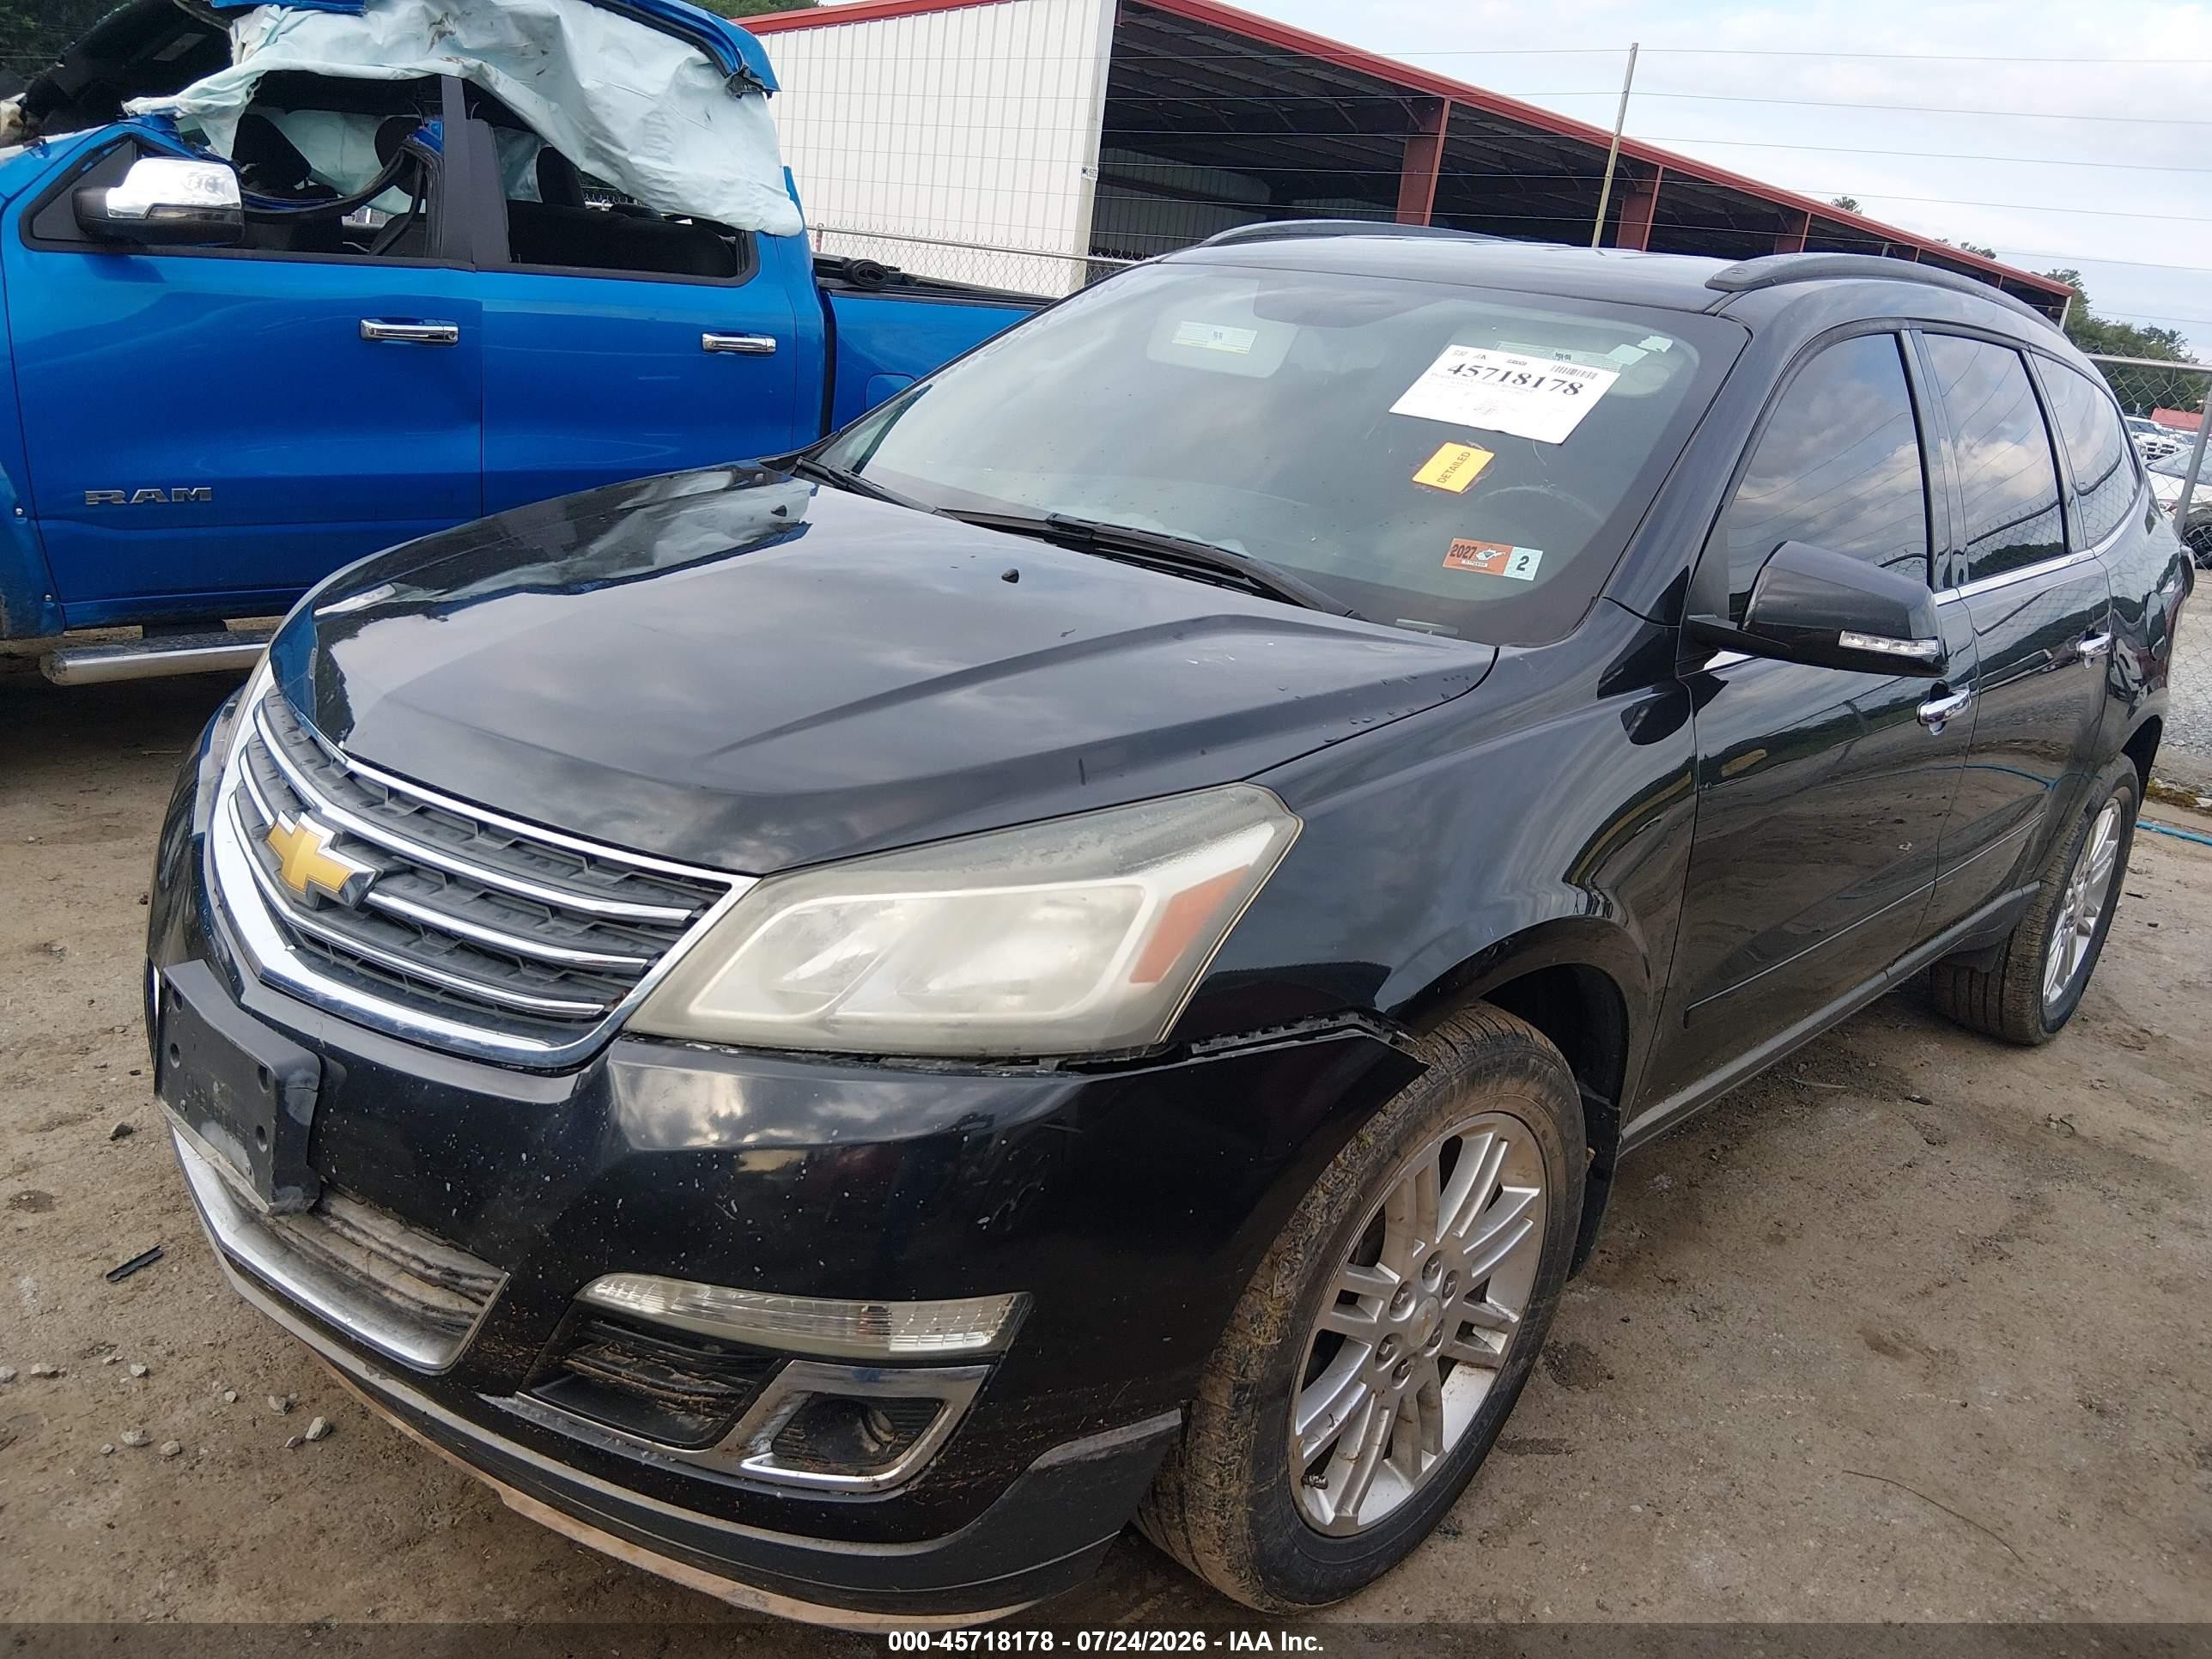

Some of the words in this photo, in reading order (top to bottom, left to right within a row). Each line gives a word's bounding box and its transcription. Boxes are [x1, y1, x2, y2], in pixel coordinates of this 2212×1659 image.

[1447, 362, 1584, 396] 45718178
[1437, 451, 1471, 483] DETAILED
[84, 487, 212, 505] RAM
[1449, 544, 1478, 560] 2027
[1516, 555, 1530, 572] 2
